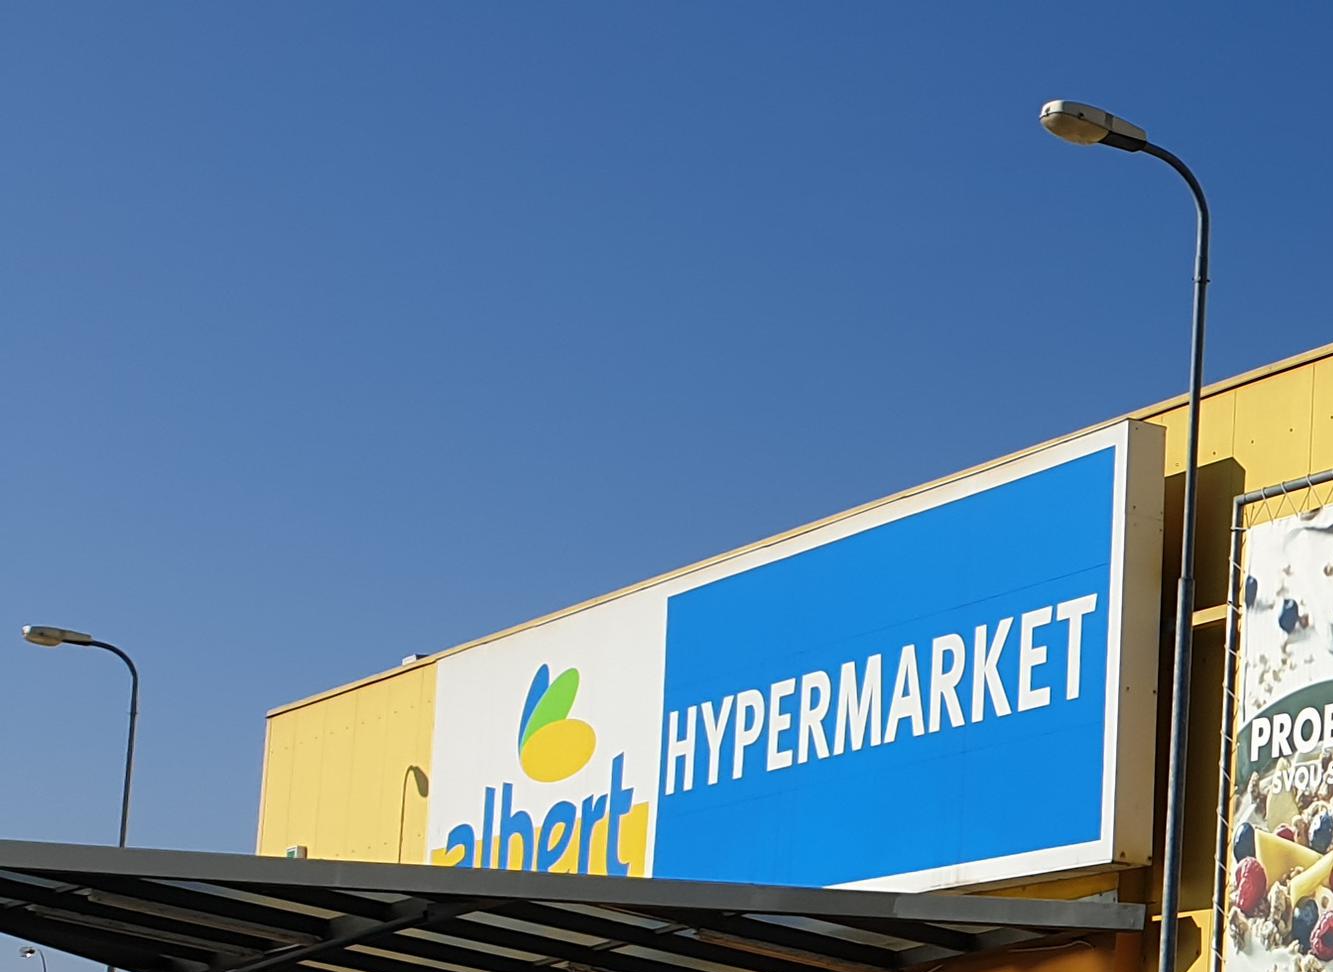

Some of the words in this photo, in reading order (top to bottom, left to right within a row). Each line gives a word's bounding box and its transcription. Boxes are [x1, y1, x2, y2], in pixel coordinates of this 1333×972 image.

[664, 592, 1099, 797] HYPERMARKET
[445, 751, 635, 877] albert
[1272, 762, 1324, 795] SVOU
